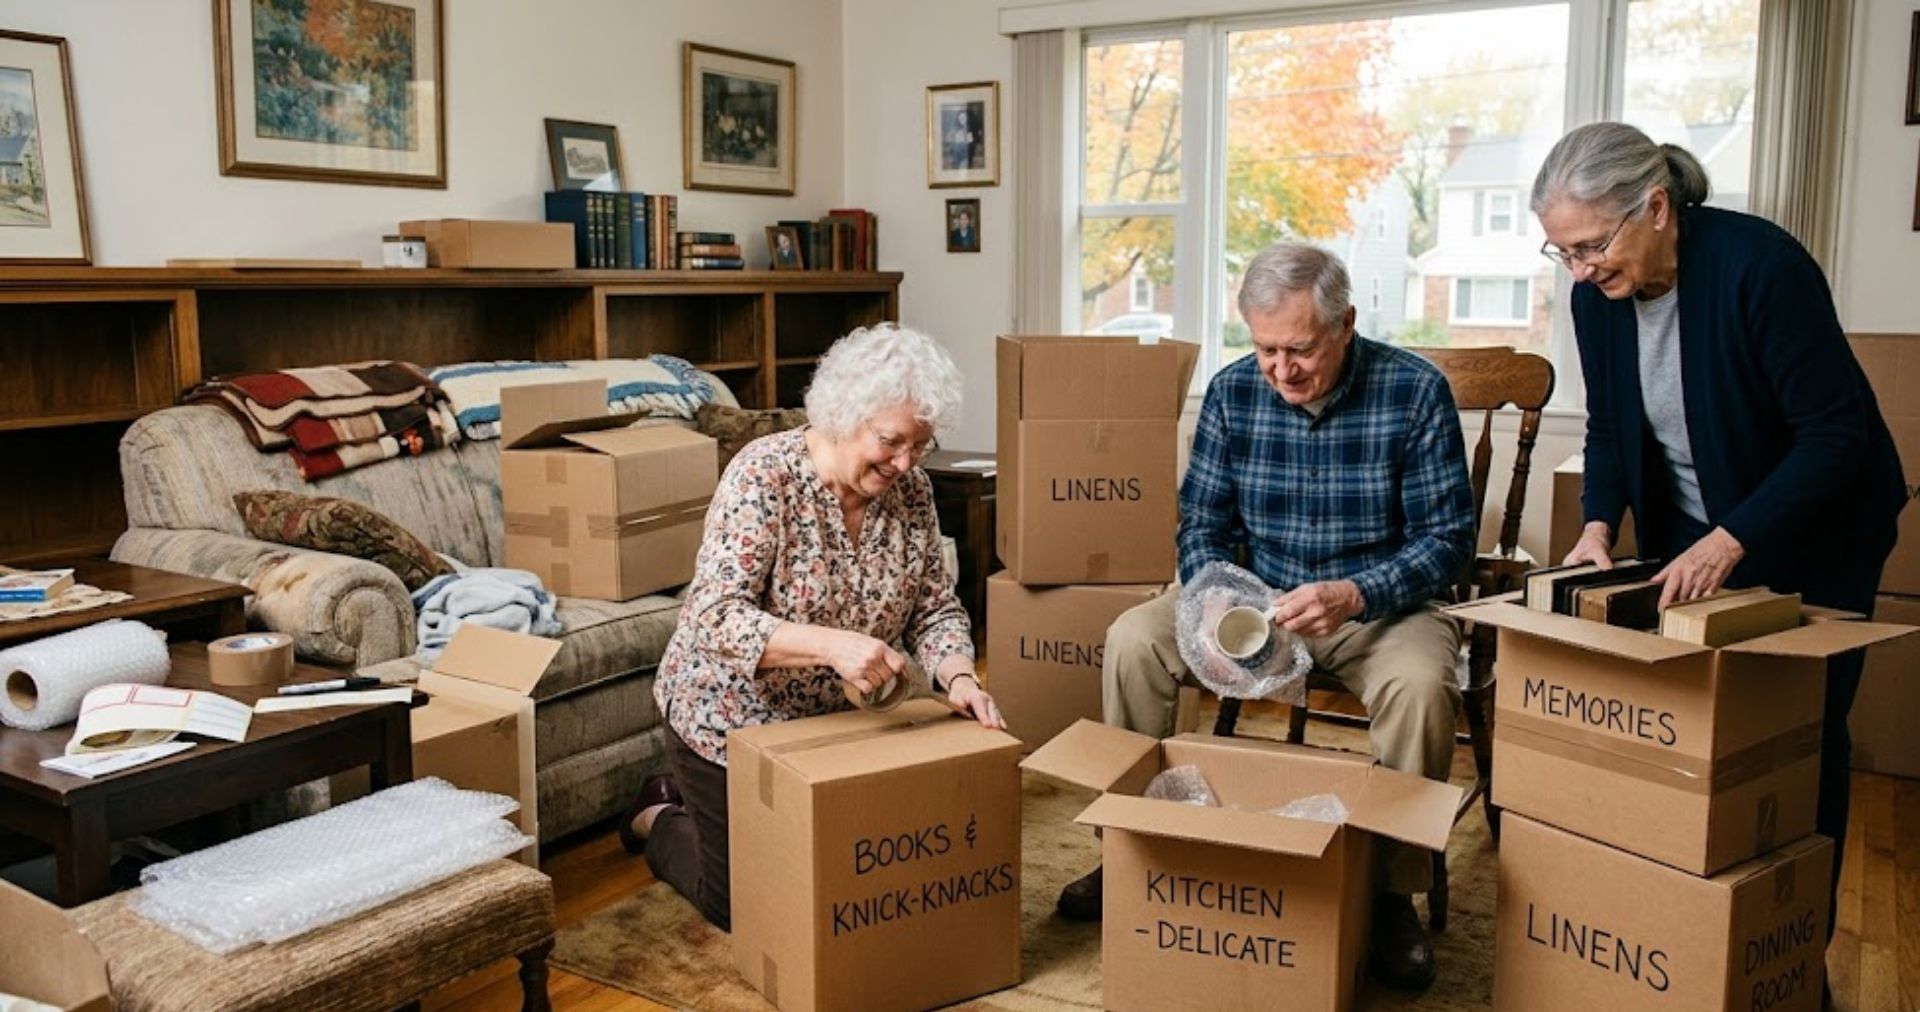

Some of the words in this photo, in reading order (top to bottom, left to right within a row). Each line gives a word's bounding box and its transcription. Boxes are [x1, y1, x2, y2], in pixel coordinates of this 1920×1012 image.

[1052, 477, 1141, 501] LINENS
[1523, 676, 1676, 746] MEMORIES
[854, 824, 951, 875] BOOKS
[833, 862, 1013, 937] KNICK-KNACKS
[1147, 869, 1283, 920] KITCHEN
[1526, 903, 1670, 993] LINENS
[1745, 909, 1816, 976] DINING
[1752, 961, 1805, 1012] ROOM
